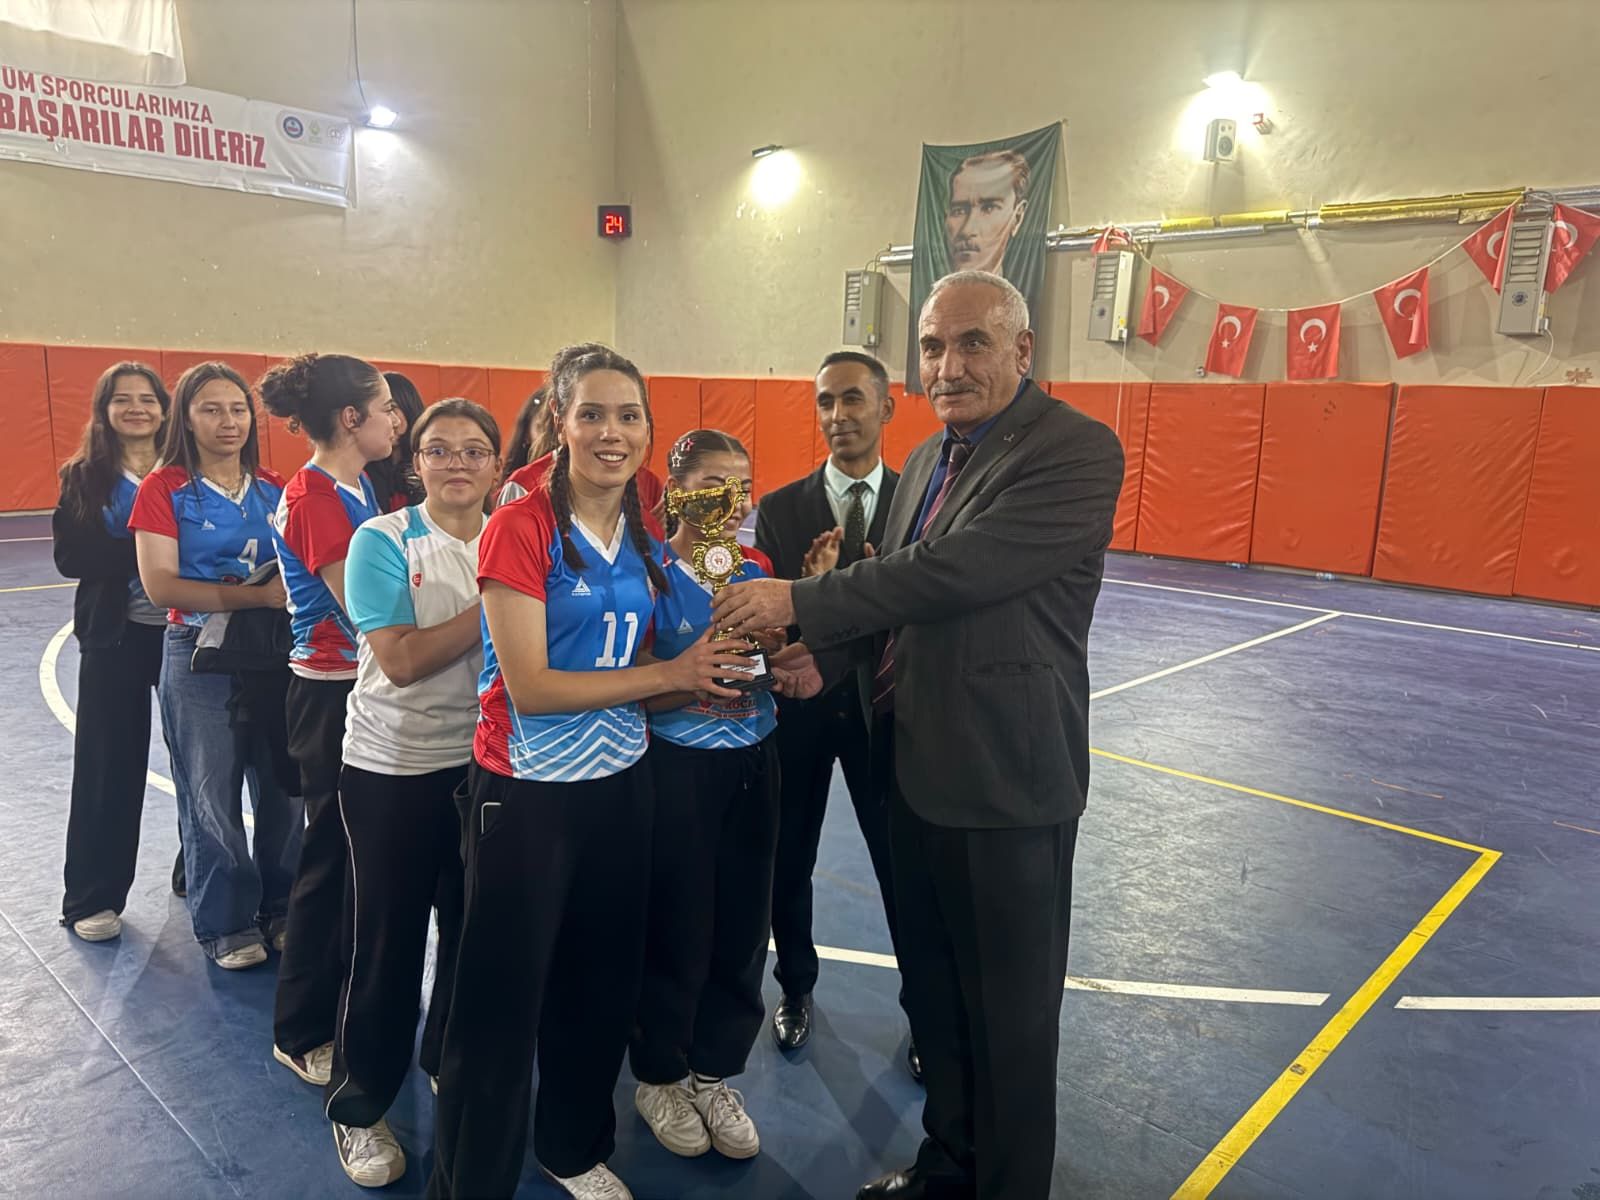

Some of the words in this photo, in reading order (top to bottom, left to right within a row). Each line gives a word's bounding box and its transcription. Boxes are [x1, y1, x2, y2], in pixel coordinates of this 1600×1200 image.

[0, 92, 165, 153] BAŞARILAR
[41, 75, 213, 124] SPORCULARIMIZA
[605, 215, 623, 234] 24
[237, 538, 258, 574] 4
[595, 611, 639, 667] 11
